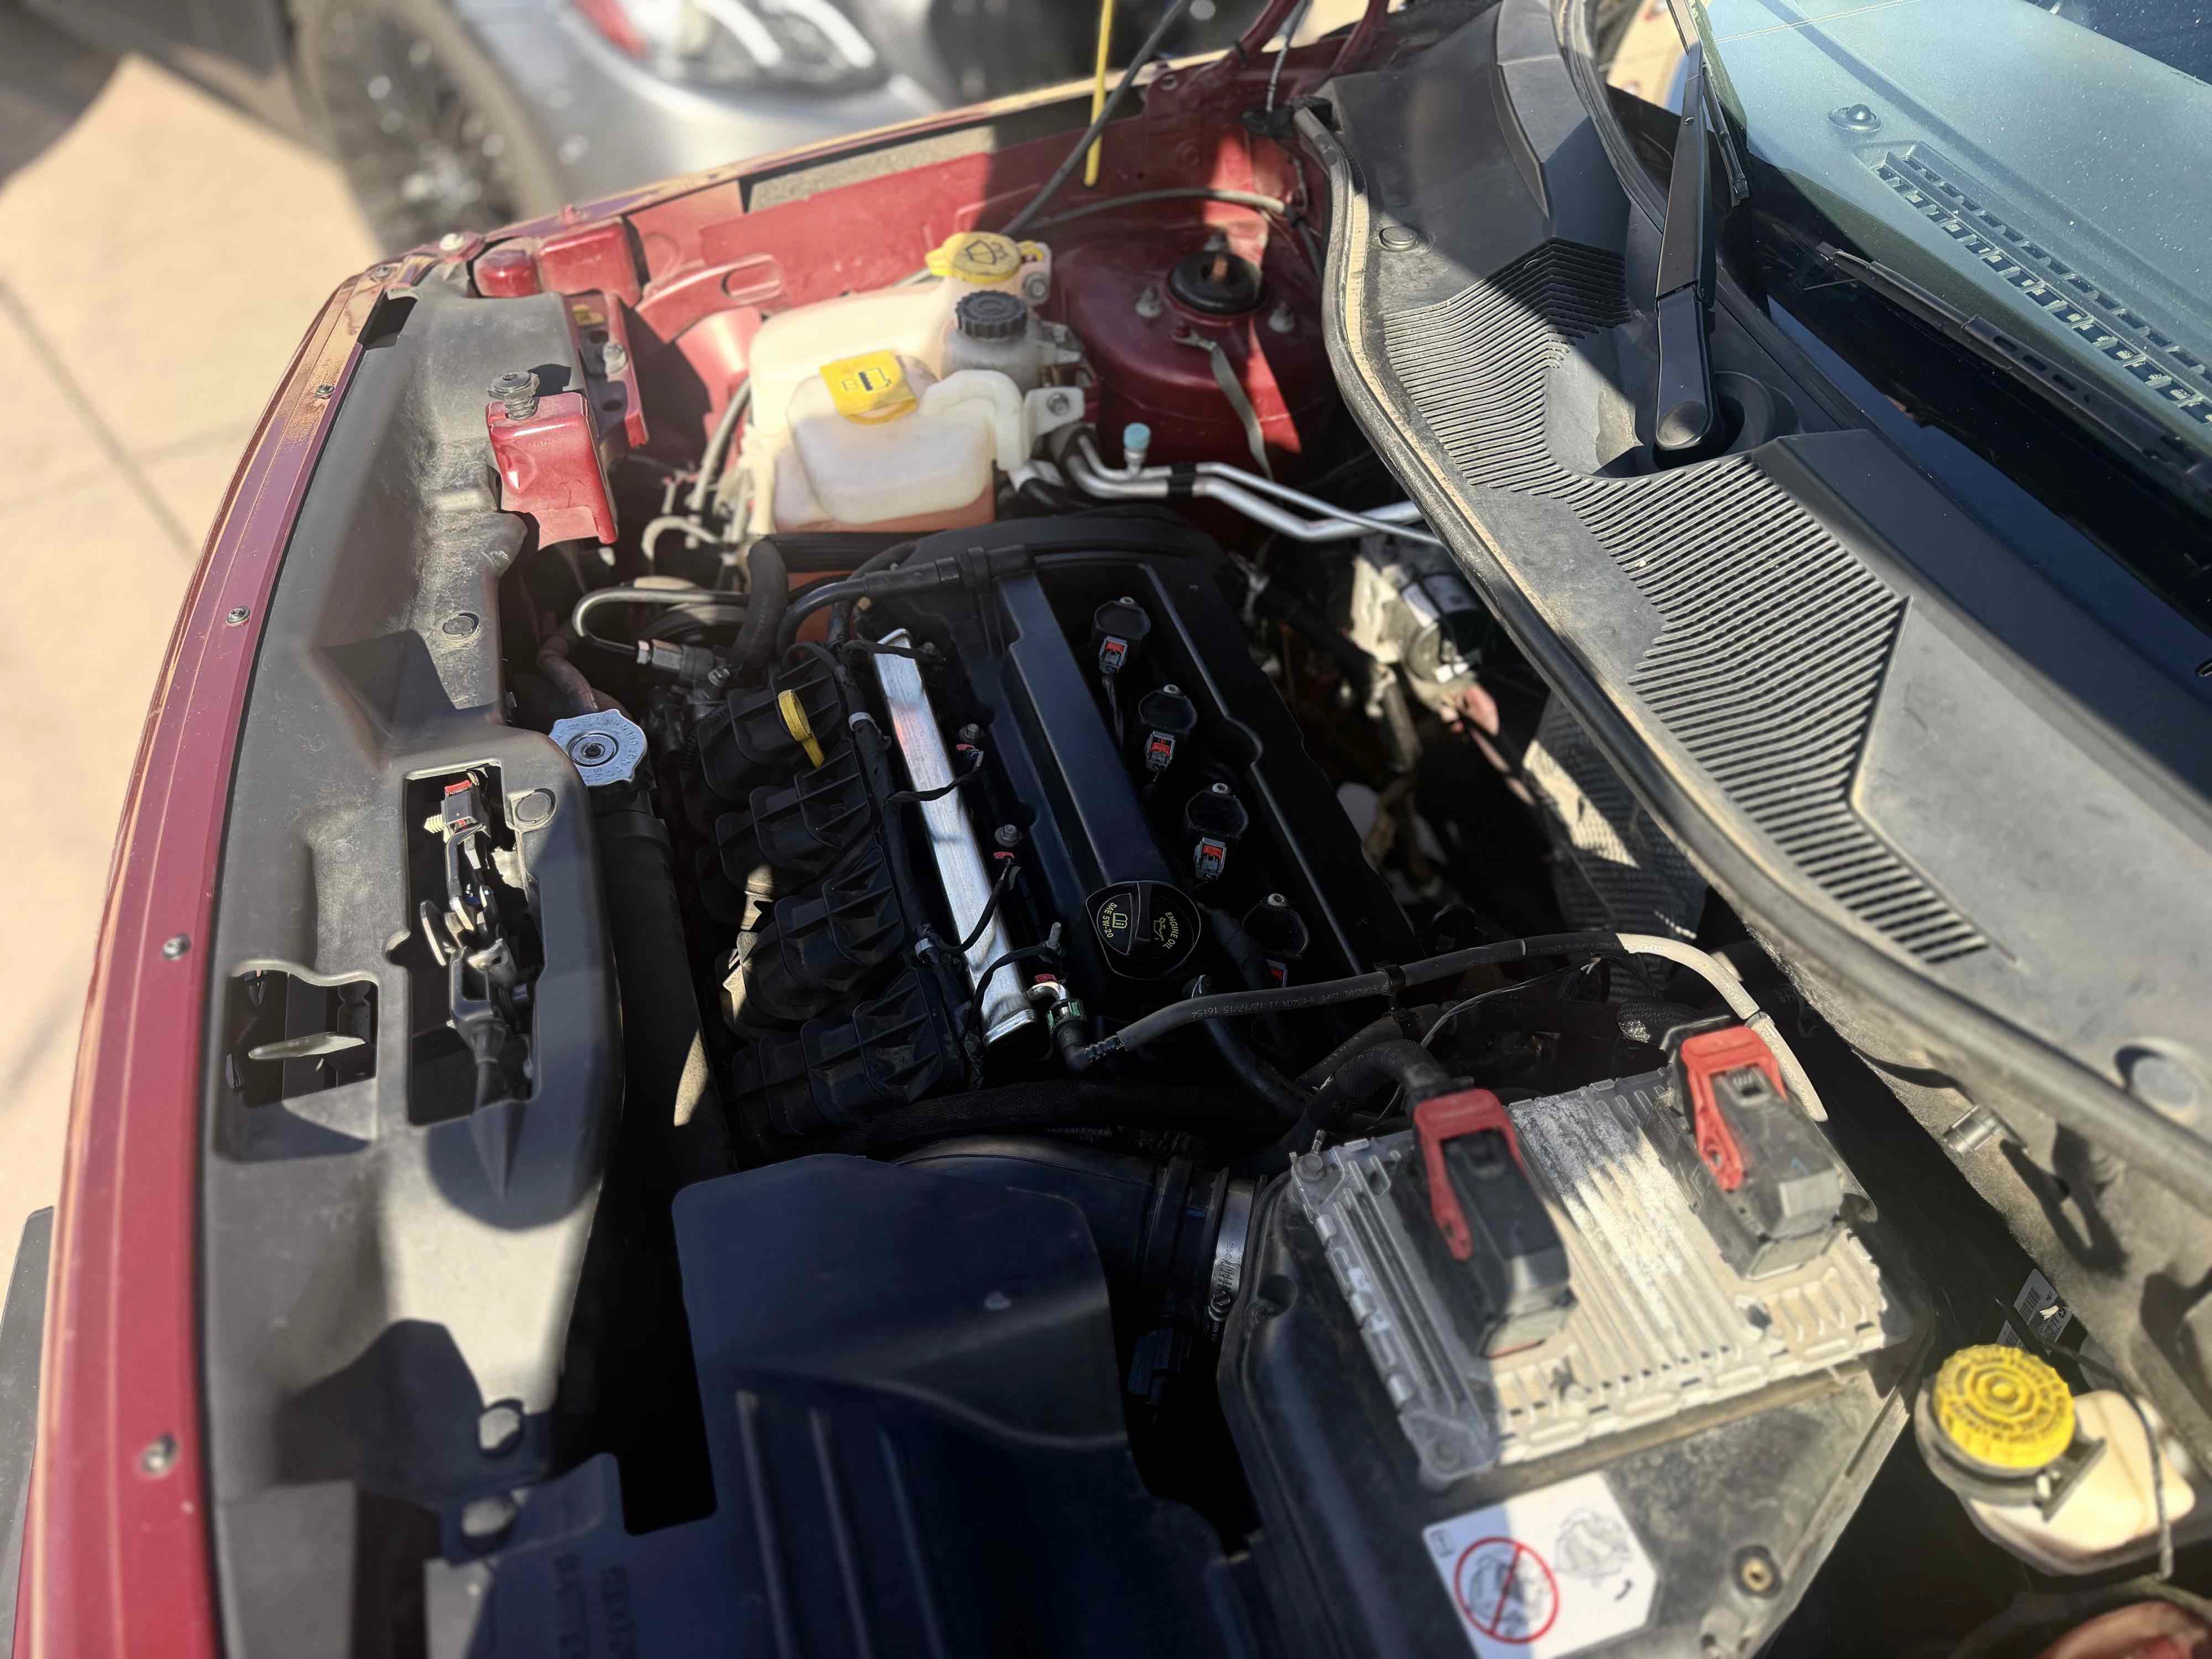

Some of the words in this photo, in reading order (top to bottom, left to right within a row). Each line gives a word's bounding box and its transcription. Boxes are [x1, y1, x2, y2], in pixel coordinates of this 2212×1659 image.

[1104, 902, 1117, 915] SAE
[1102, 915, 1114, 938] 5W-20
[1165, 911, 1178, 938] ENGINE
[1162, 939, 1176, 949] OIL
